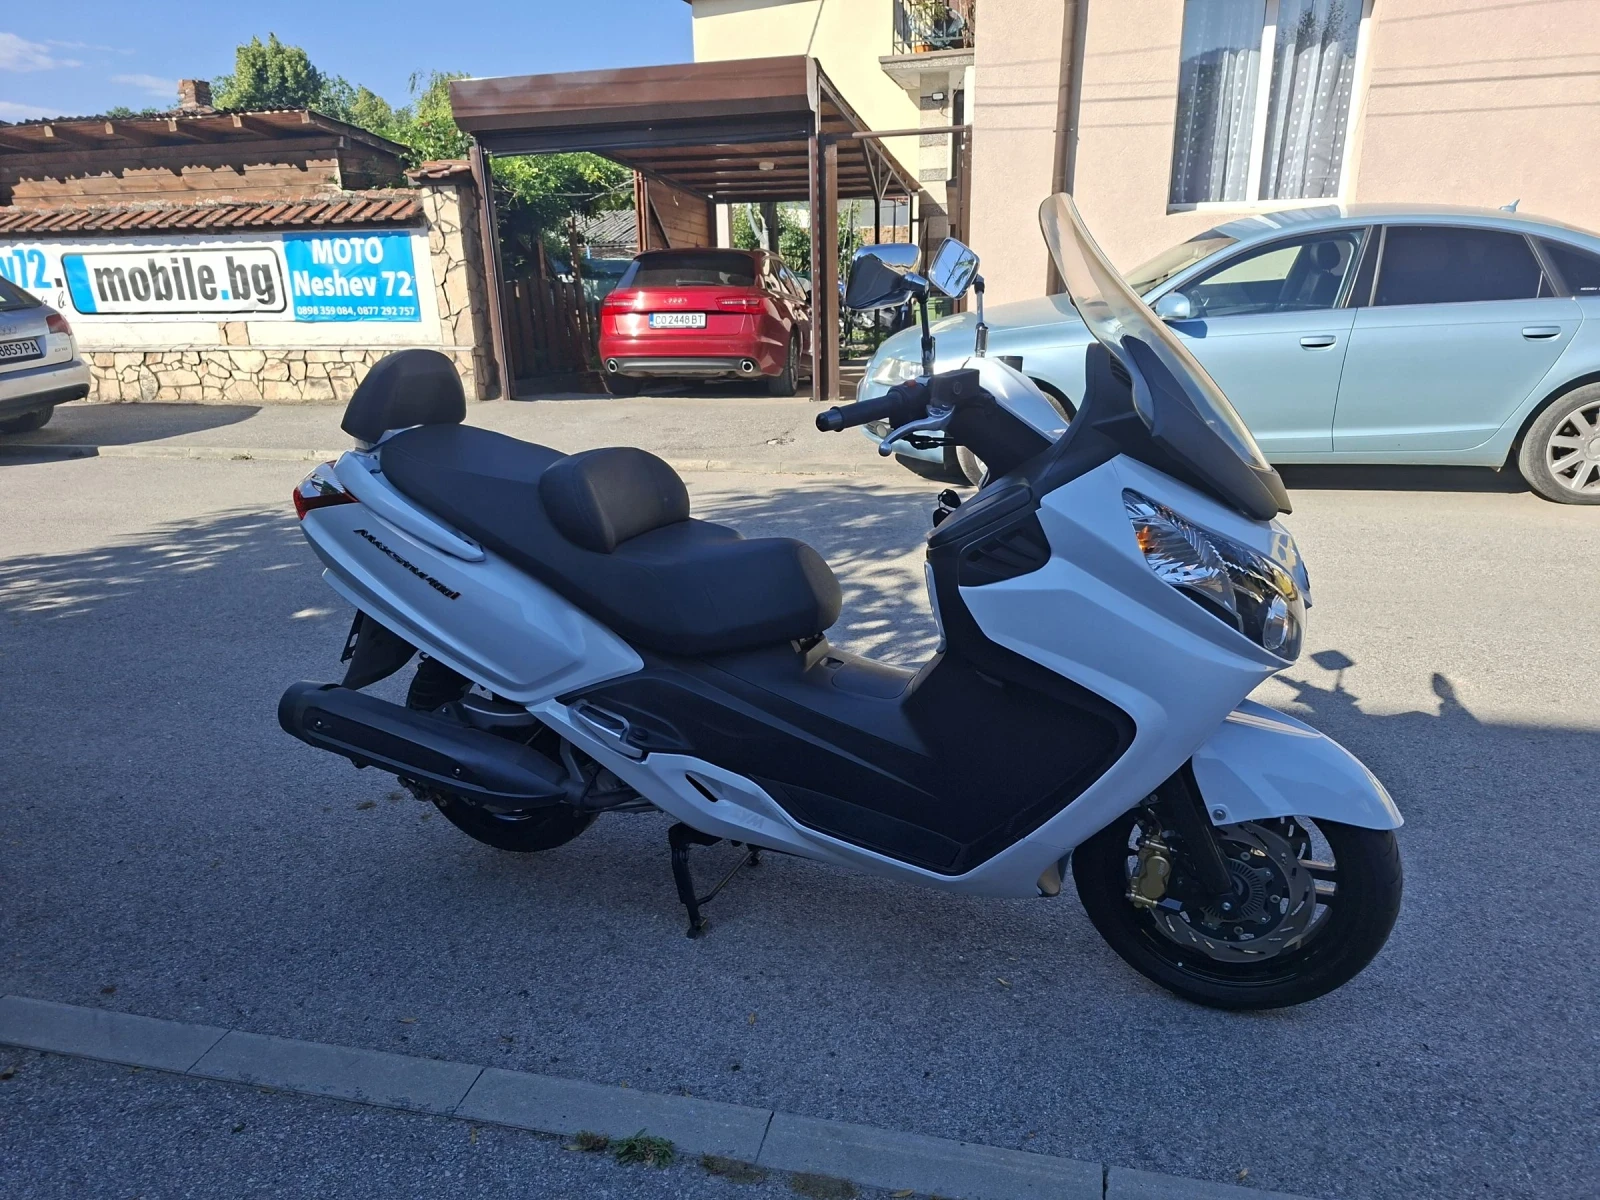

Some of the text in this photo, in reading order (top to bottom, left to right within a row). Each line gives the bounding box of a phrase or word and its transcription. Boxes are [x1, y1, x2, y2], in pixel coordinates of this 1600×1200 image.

[311, 237, 383, 264] MOTO
[94, 256, 276, 305] mobile.bg
[293, 269, 413, 297] Neshev 72
[297, 305, 415, 317] 0898 359 084, 0877 292 757
